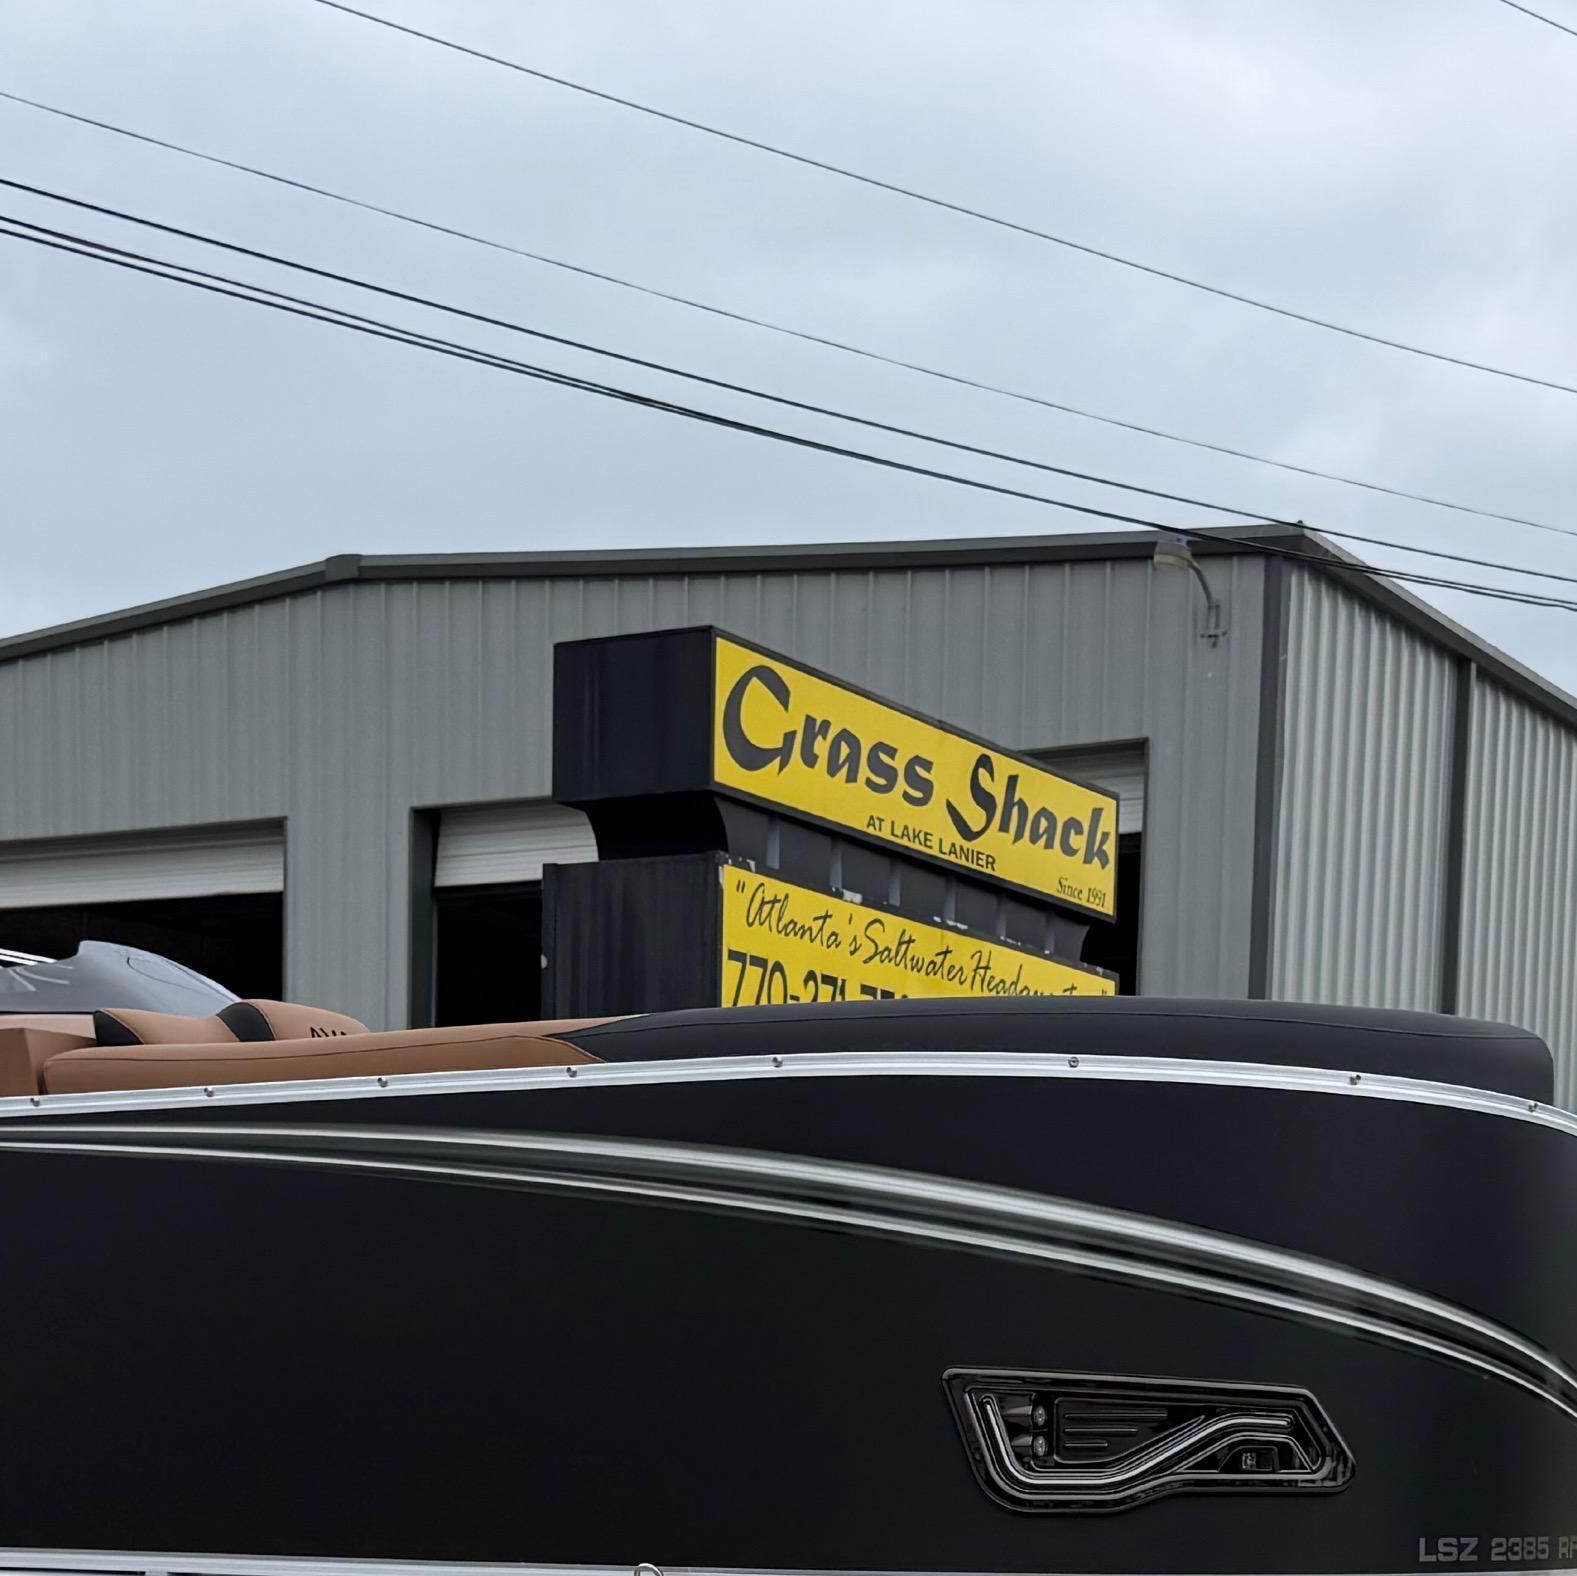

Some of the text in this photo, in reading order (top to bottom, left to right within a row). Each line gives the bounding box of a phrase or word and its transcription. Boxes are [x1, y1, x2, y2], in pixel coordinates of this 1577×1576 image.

[723, 665, 1111, 870] Grass Shack
[866, 815, 996, 872] AT LAKE LANIER
[1057, 876, 1083, 901] Since
[863, 918, 967, 986] Saltwater
[1418, 1537, 1479, 1562] LSZ
[1490, 1536, 1550, 1562] 2385
